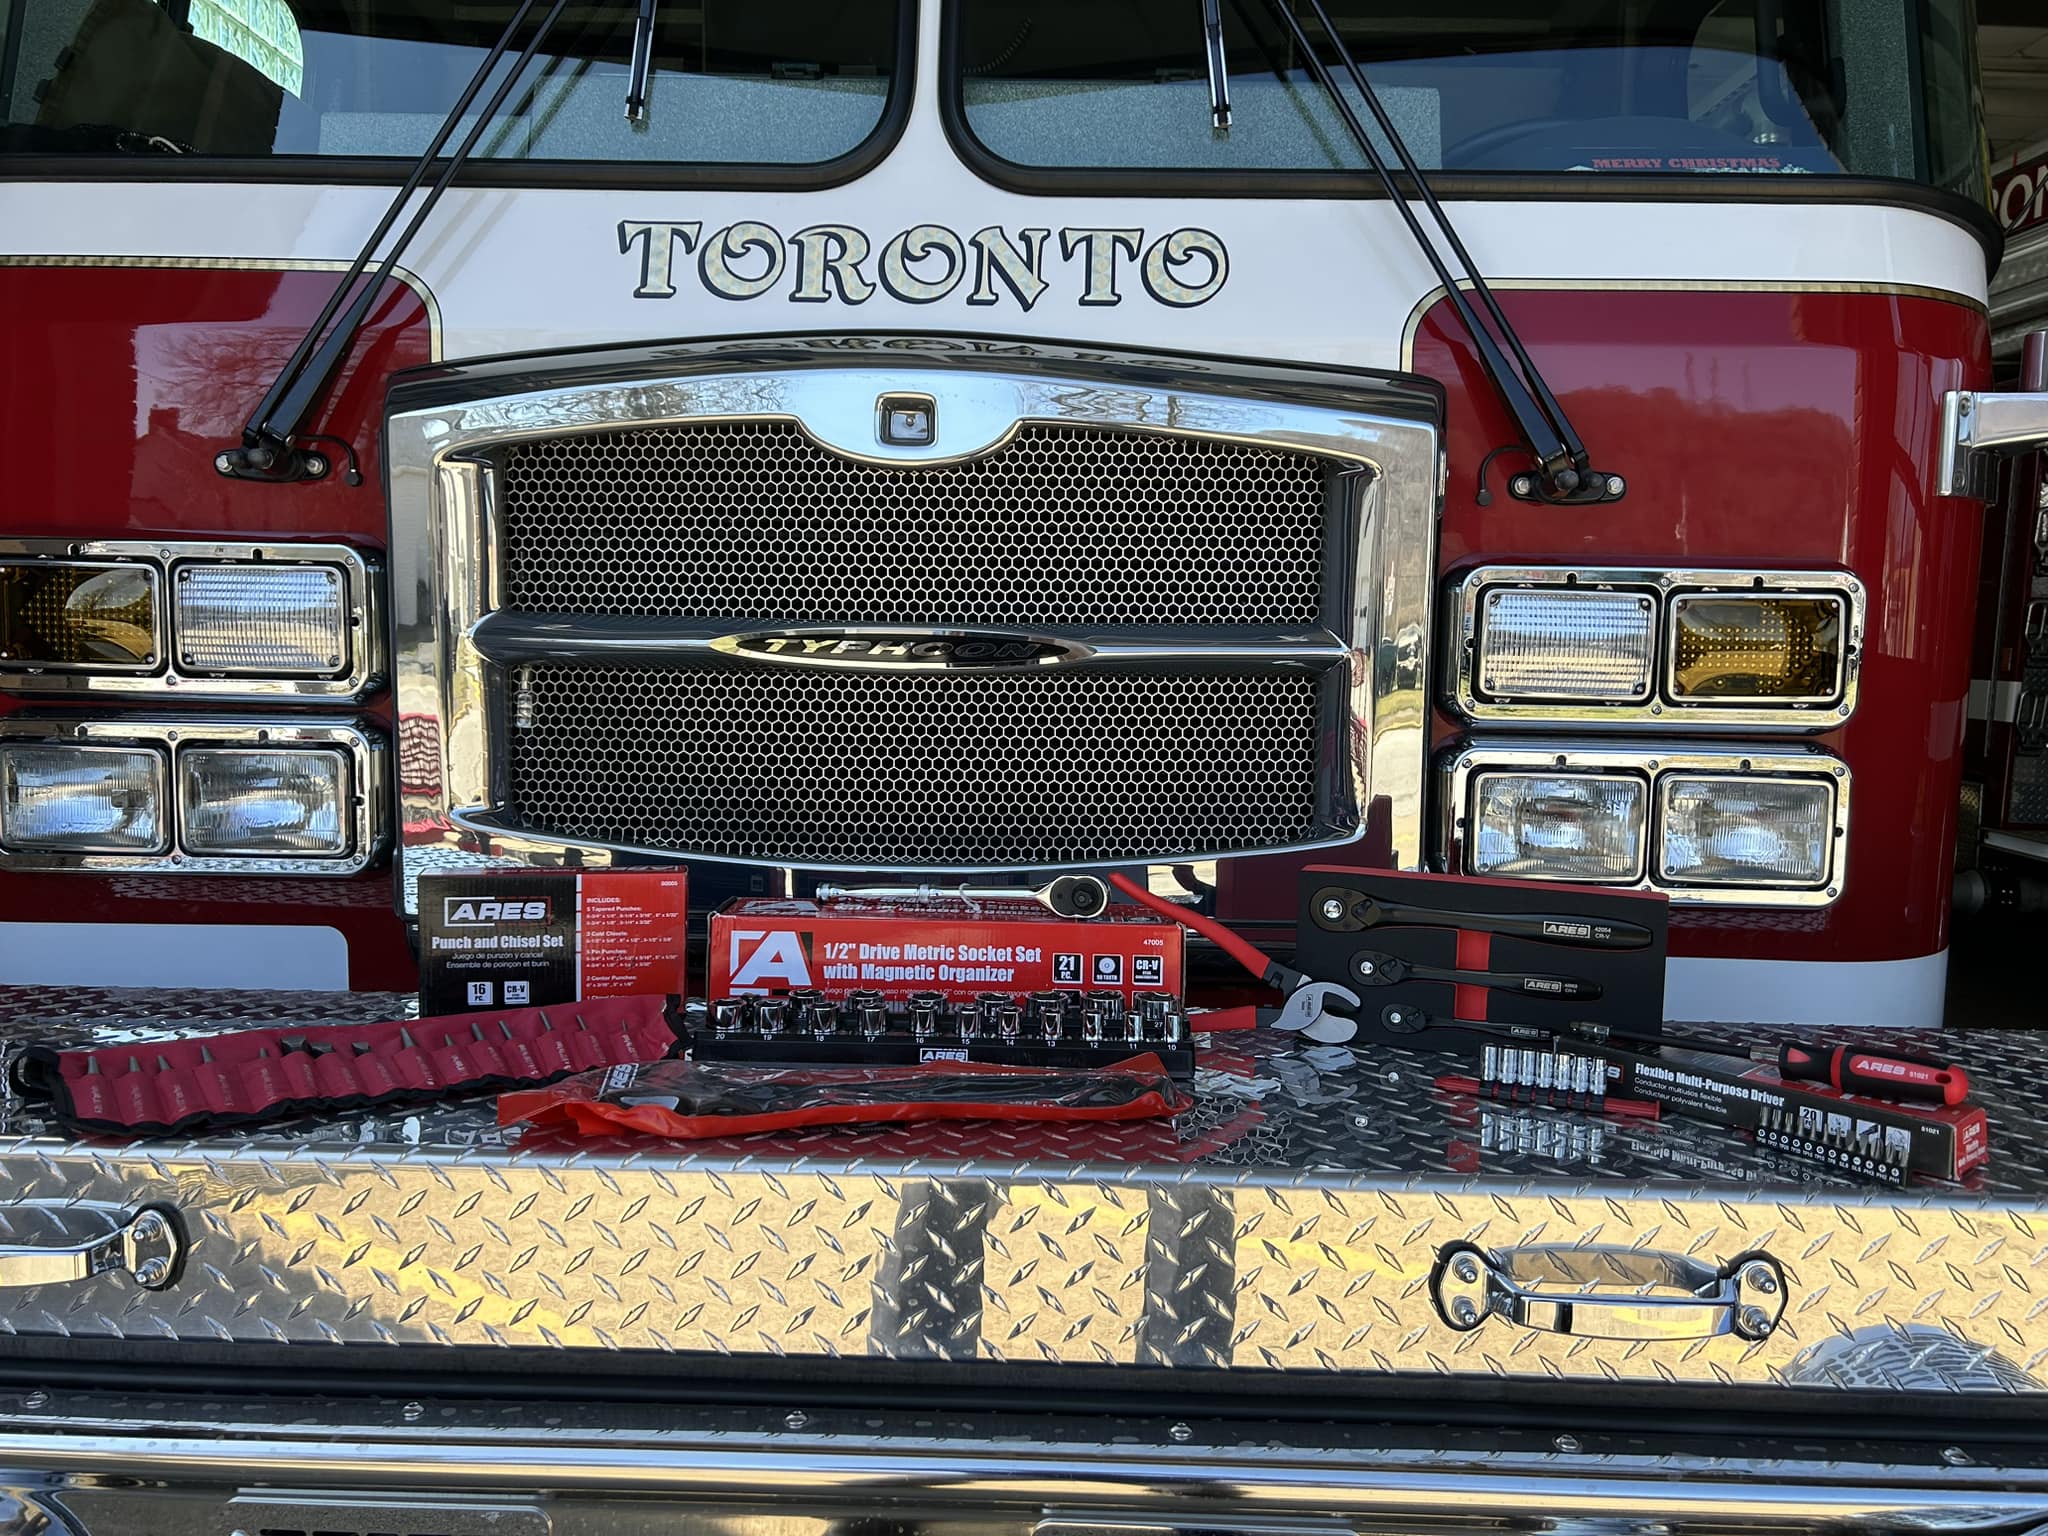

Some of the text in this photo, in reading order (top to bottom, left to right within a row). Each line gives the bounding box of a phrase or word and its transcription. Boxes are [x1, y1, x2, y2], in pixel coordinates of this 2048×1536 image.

[1592, 158, 1780, 168] MERRY CHRISTMAS
[618, 220, 1229, 312] TORONTO
[765, 638, 1041, 658] TYPHOON
[450, 902, 546, 920] ARES
[1546, 924, 1588, 936] ARES
[432, 934, 564, 950] Punch and Chisel Set
[452, 952, 474, 960] Juego
[476, 952, 486, 960] de
[824, 943, 1041, 964] 1/2" Drive Metric Socket Set
[522, 960, 530, 968] et
[1058, 956, 1075, 971] 21
[1136, 960, 1159, 970] CR-V
[823, 963, 1015, 983] with Magnetic Organizer
[1060, 972, 1073, 980] PC.
[472, 983, 486, 995] 16
[506, 984, 526, 994] CR-V
[1528, 981, 1559, 990] ARES
[715, 1032, 726, 1040] 20
[922, 1050, 966, 1060] ARES
[1856, 1060, 1906, 1076] ARES
[1634, 1078, 1668, 1090] Conductor
[1668, 1085, 1699, 1098] multiusos
[1635, 1062, 1674, 1082] Flexible
[1676, 1074, 1749, 1100] Multi-Purpose
[1750, 1088, 1785, 1107] Driver
[1634, 1086, 1670, 1100] Conducteur
[1671, 1094, 1704, 1108] polyvalent
[1803, 1108, 1816, 1120] 20
